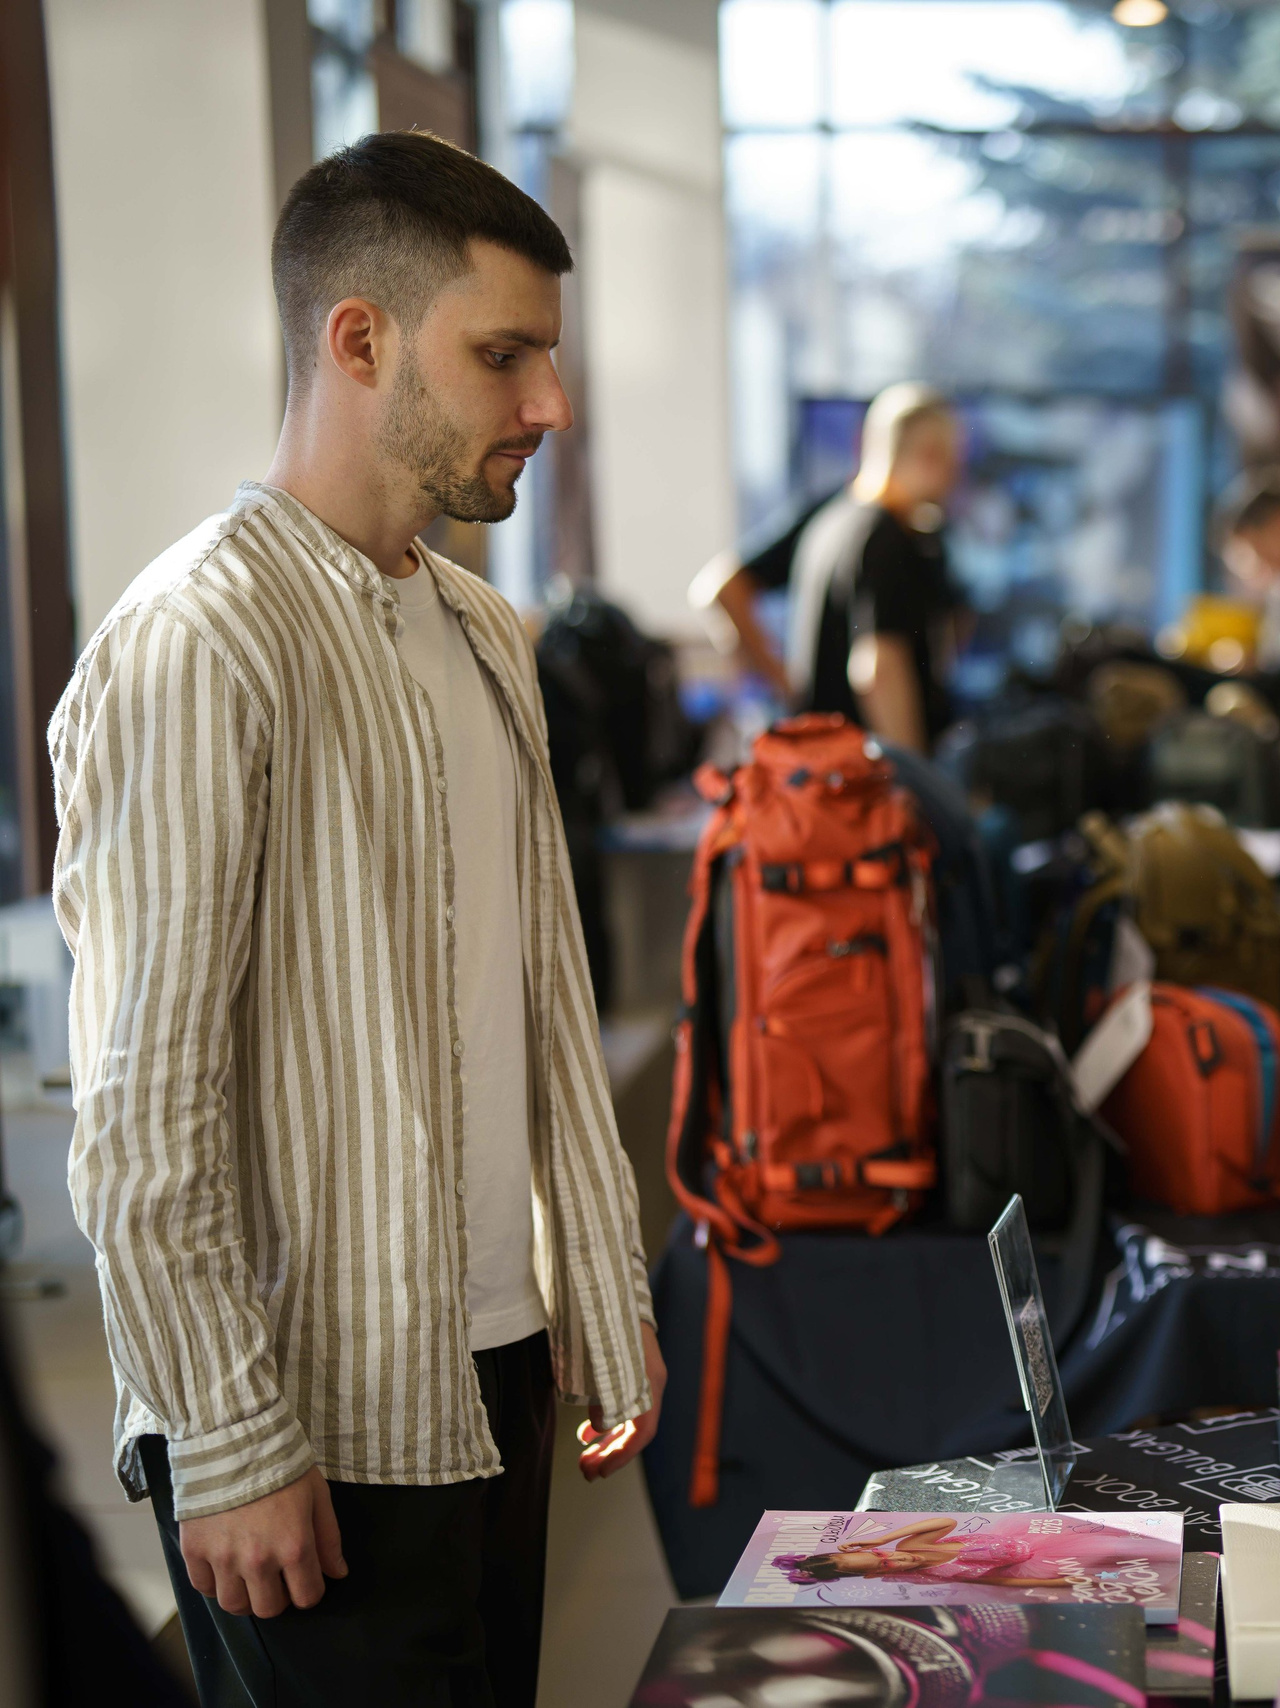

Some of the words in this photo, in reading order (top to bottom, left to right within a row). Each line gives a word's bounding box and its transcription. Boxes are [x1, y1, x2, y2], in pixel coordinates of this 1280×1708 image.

[1107, 1429, 1236, 1475] BULGAK
[900, 1463, 1033, 1513] BULGAK
[1072, 1473, 1180, 1509] BOOK
[1041, 1518, 1063, 1535] 2025
